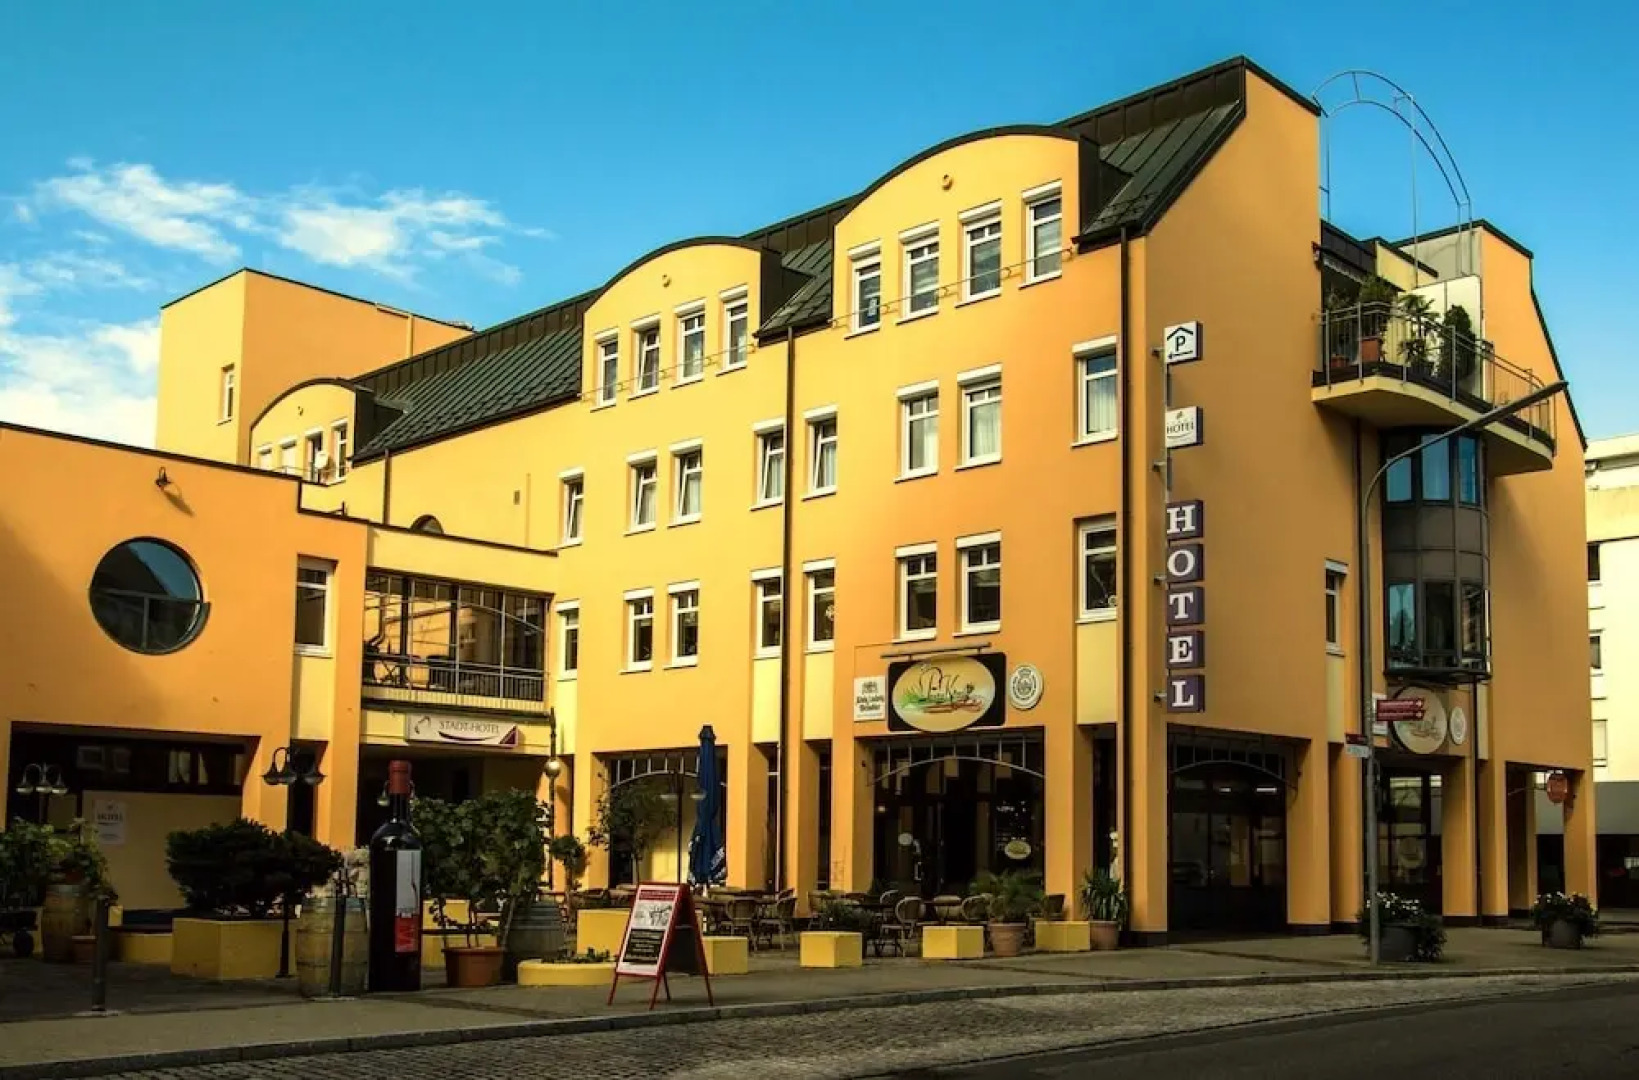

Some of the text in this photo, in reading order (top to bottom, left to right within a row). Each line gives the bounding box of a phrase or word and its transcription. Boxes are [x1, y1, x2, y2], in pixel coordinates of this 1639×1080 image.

[1175, 335, 1186, 352] P
[1166, 421, 1194, 434] HOTEL
[1166, 504, 1196, 707] HOTEL
